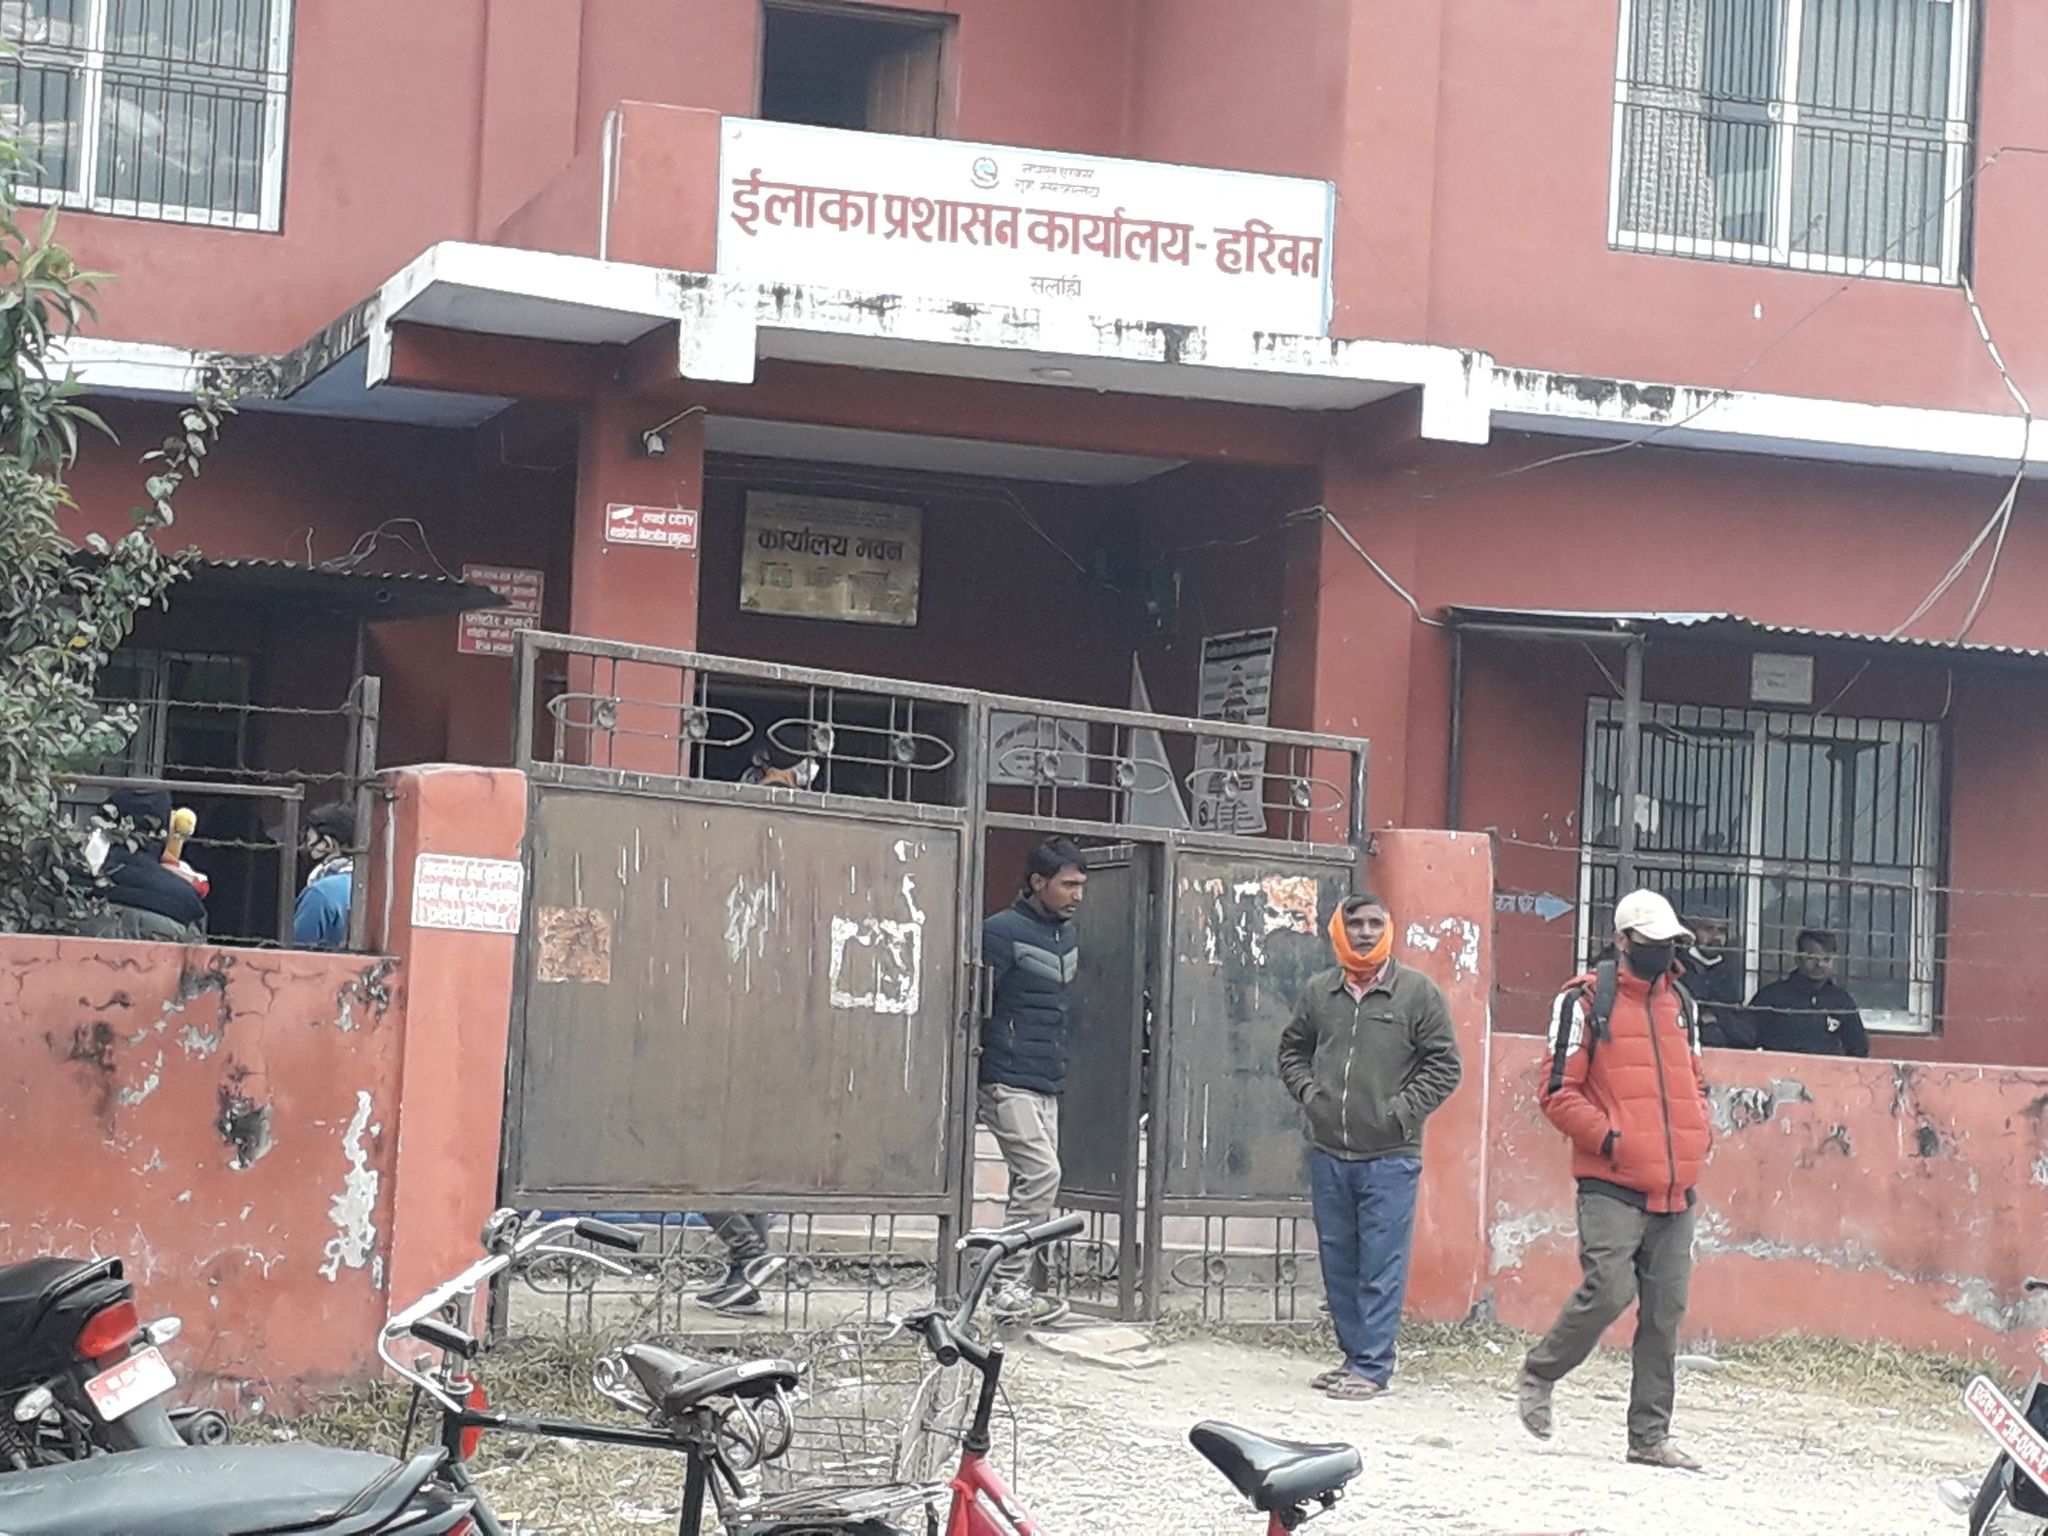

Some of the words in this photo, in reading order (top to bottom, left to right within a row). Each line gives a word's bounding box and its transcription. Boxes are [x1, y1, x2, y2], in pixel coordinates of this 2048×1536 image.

[731, 168, 876, 237] ईलाका
[883, 191, 1020, 250] प्रशासन
[757, 525, 849, 558] कार्यालय
